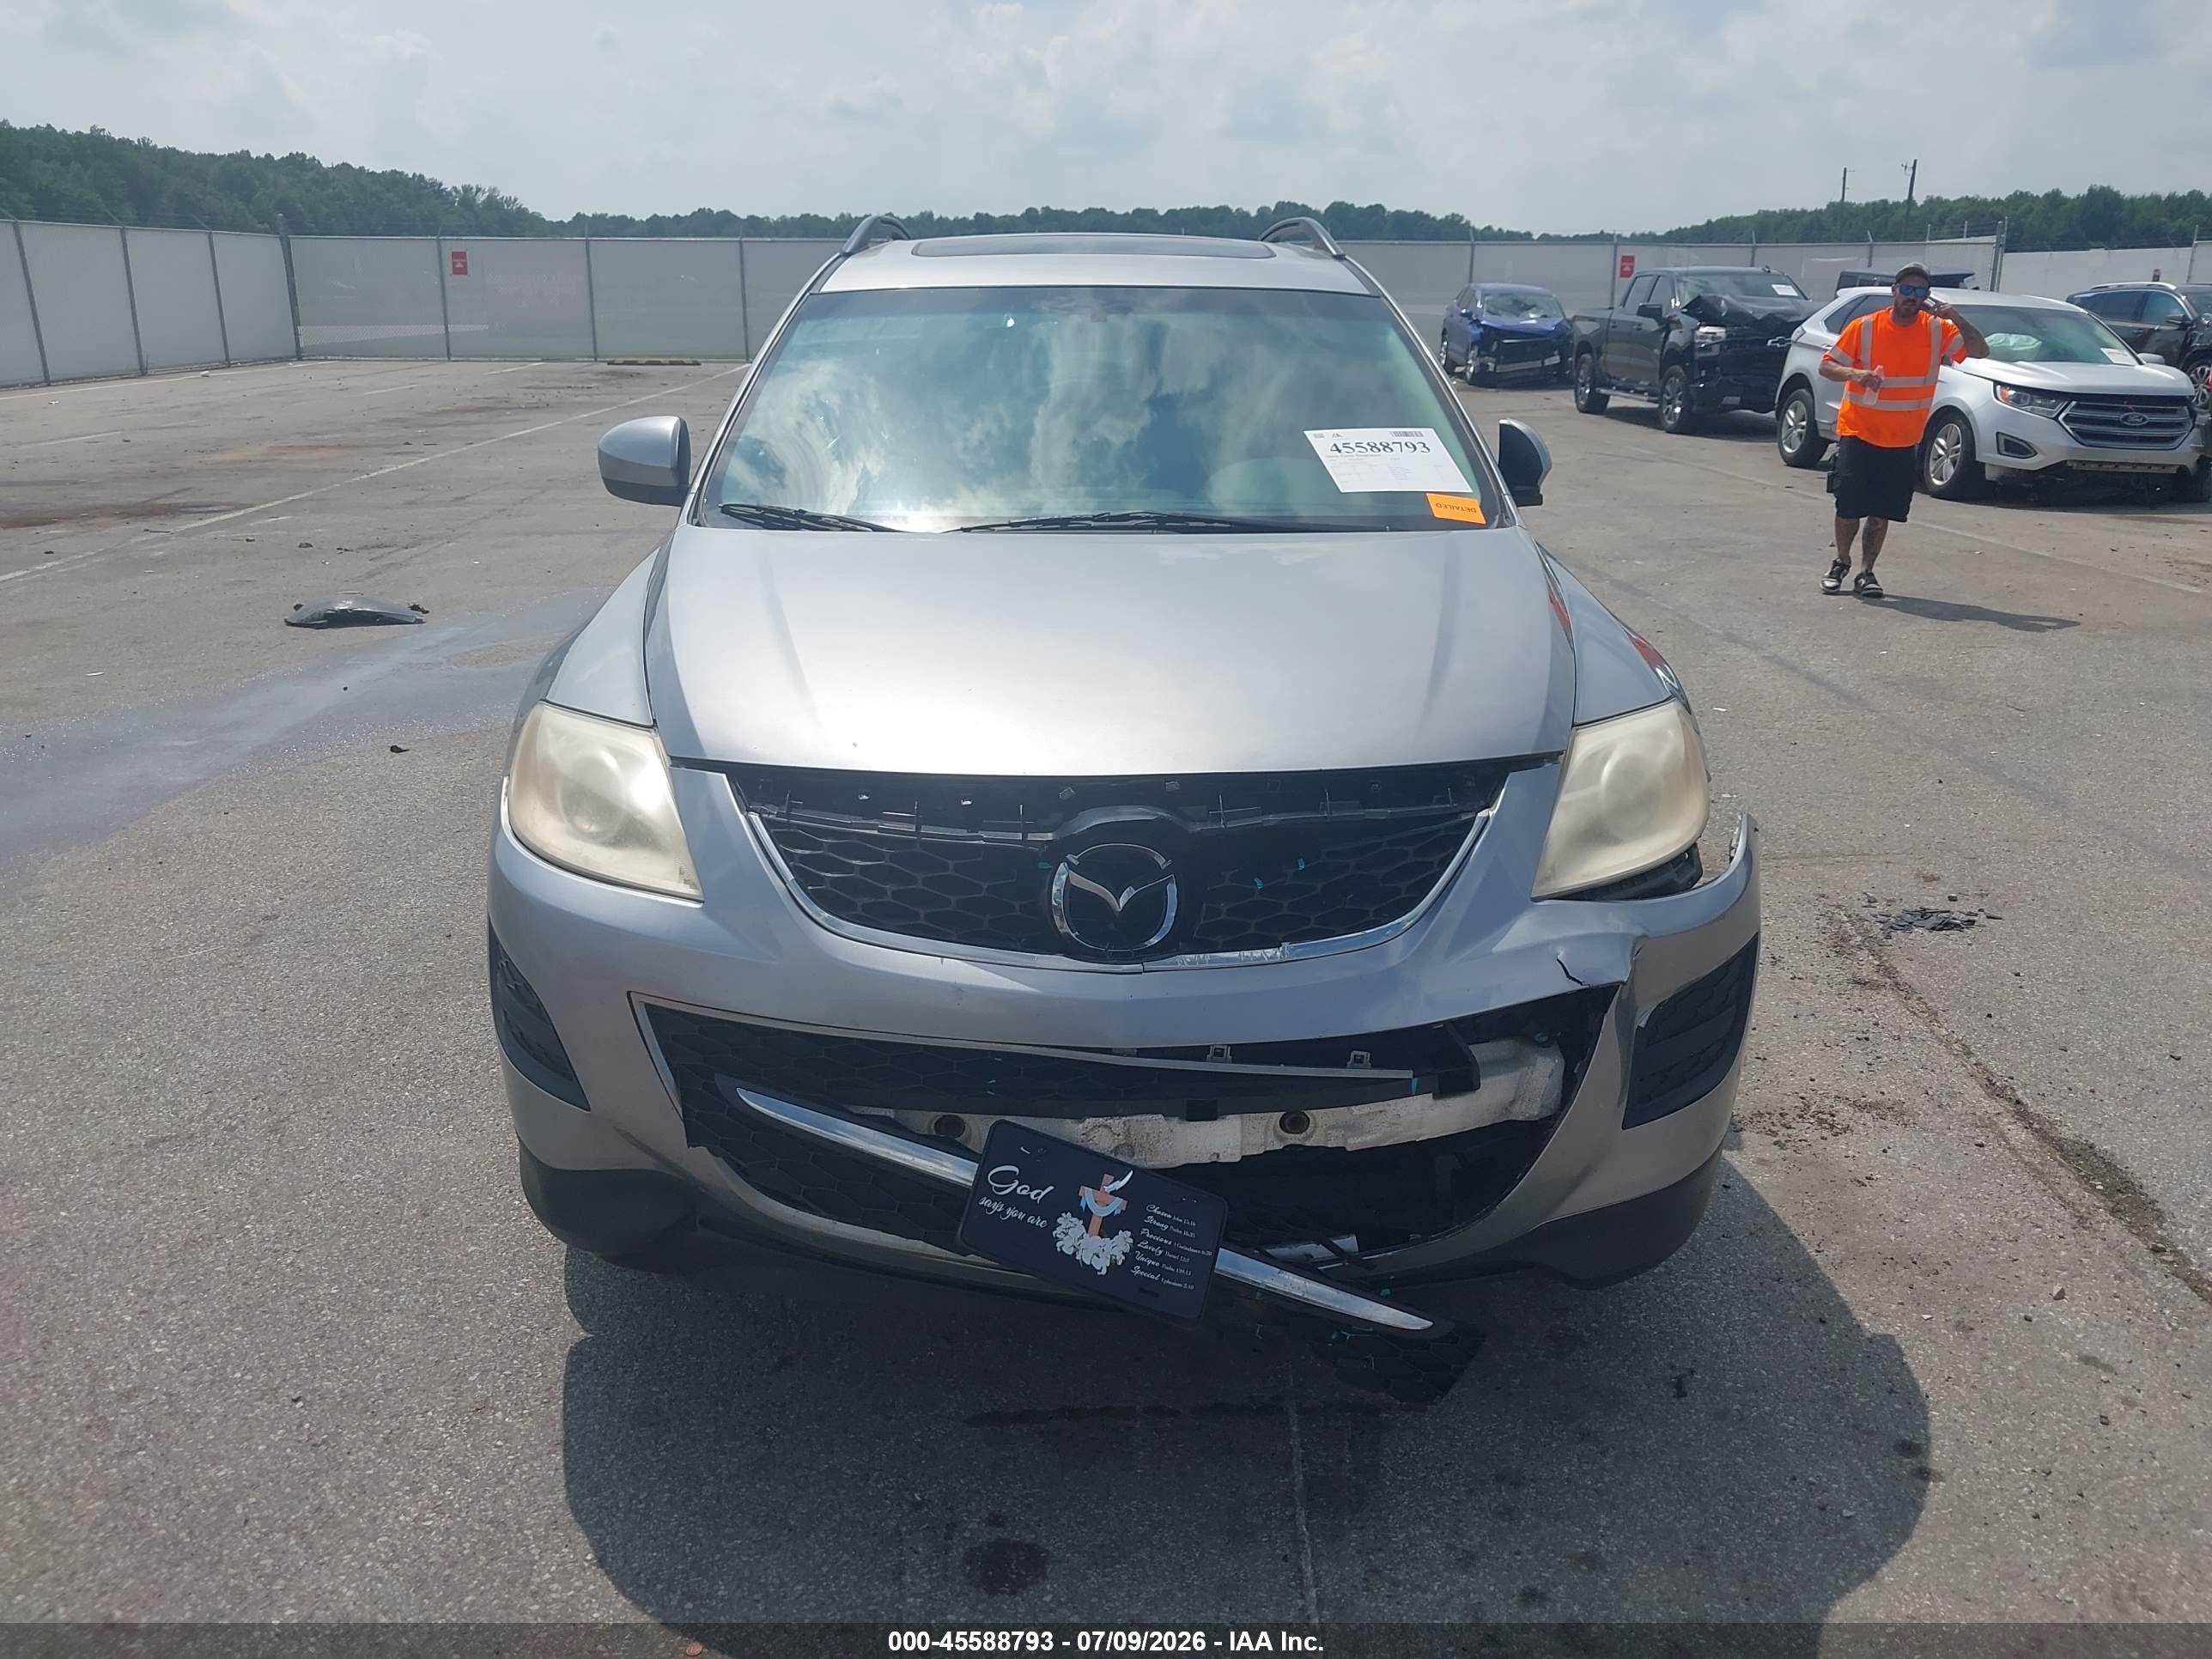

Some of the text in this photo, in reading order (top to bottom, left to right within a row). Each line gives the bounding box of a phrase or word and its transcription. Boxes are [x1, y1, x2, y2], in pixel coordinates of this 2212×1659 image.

[1330, 441, 1431, 453] 45588793
[1435, 502, 1477, 513] DETAILED
[988, 1164, 1054, 1205] God
[978, 1195, 1048, 1228] says you are
[1146, 1204, 1172, 1218] Chosen
[1144, 1215, 1169, 1231] Strong
[1140, 1228, 1172, 1245] Precious
[1137, 1240, 1164, 1256] Lovely
[1134, 1250, 1160, 1267] Unique
[1130, 1266, 1161, 1280] Special
